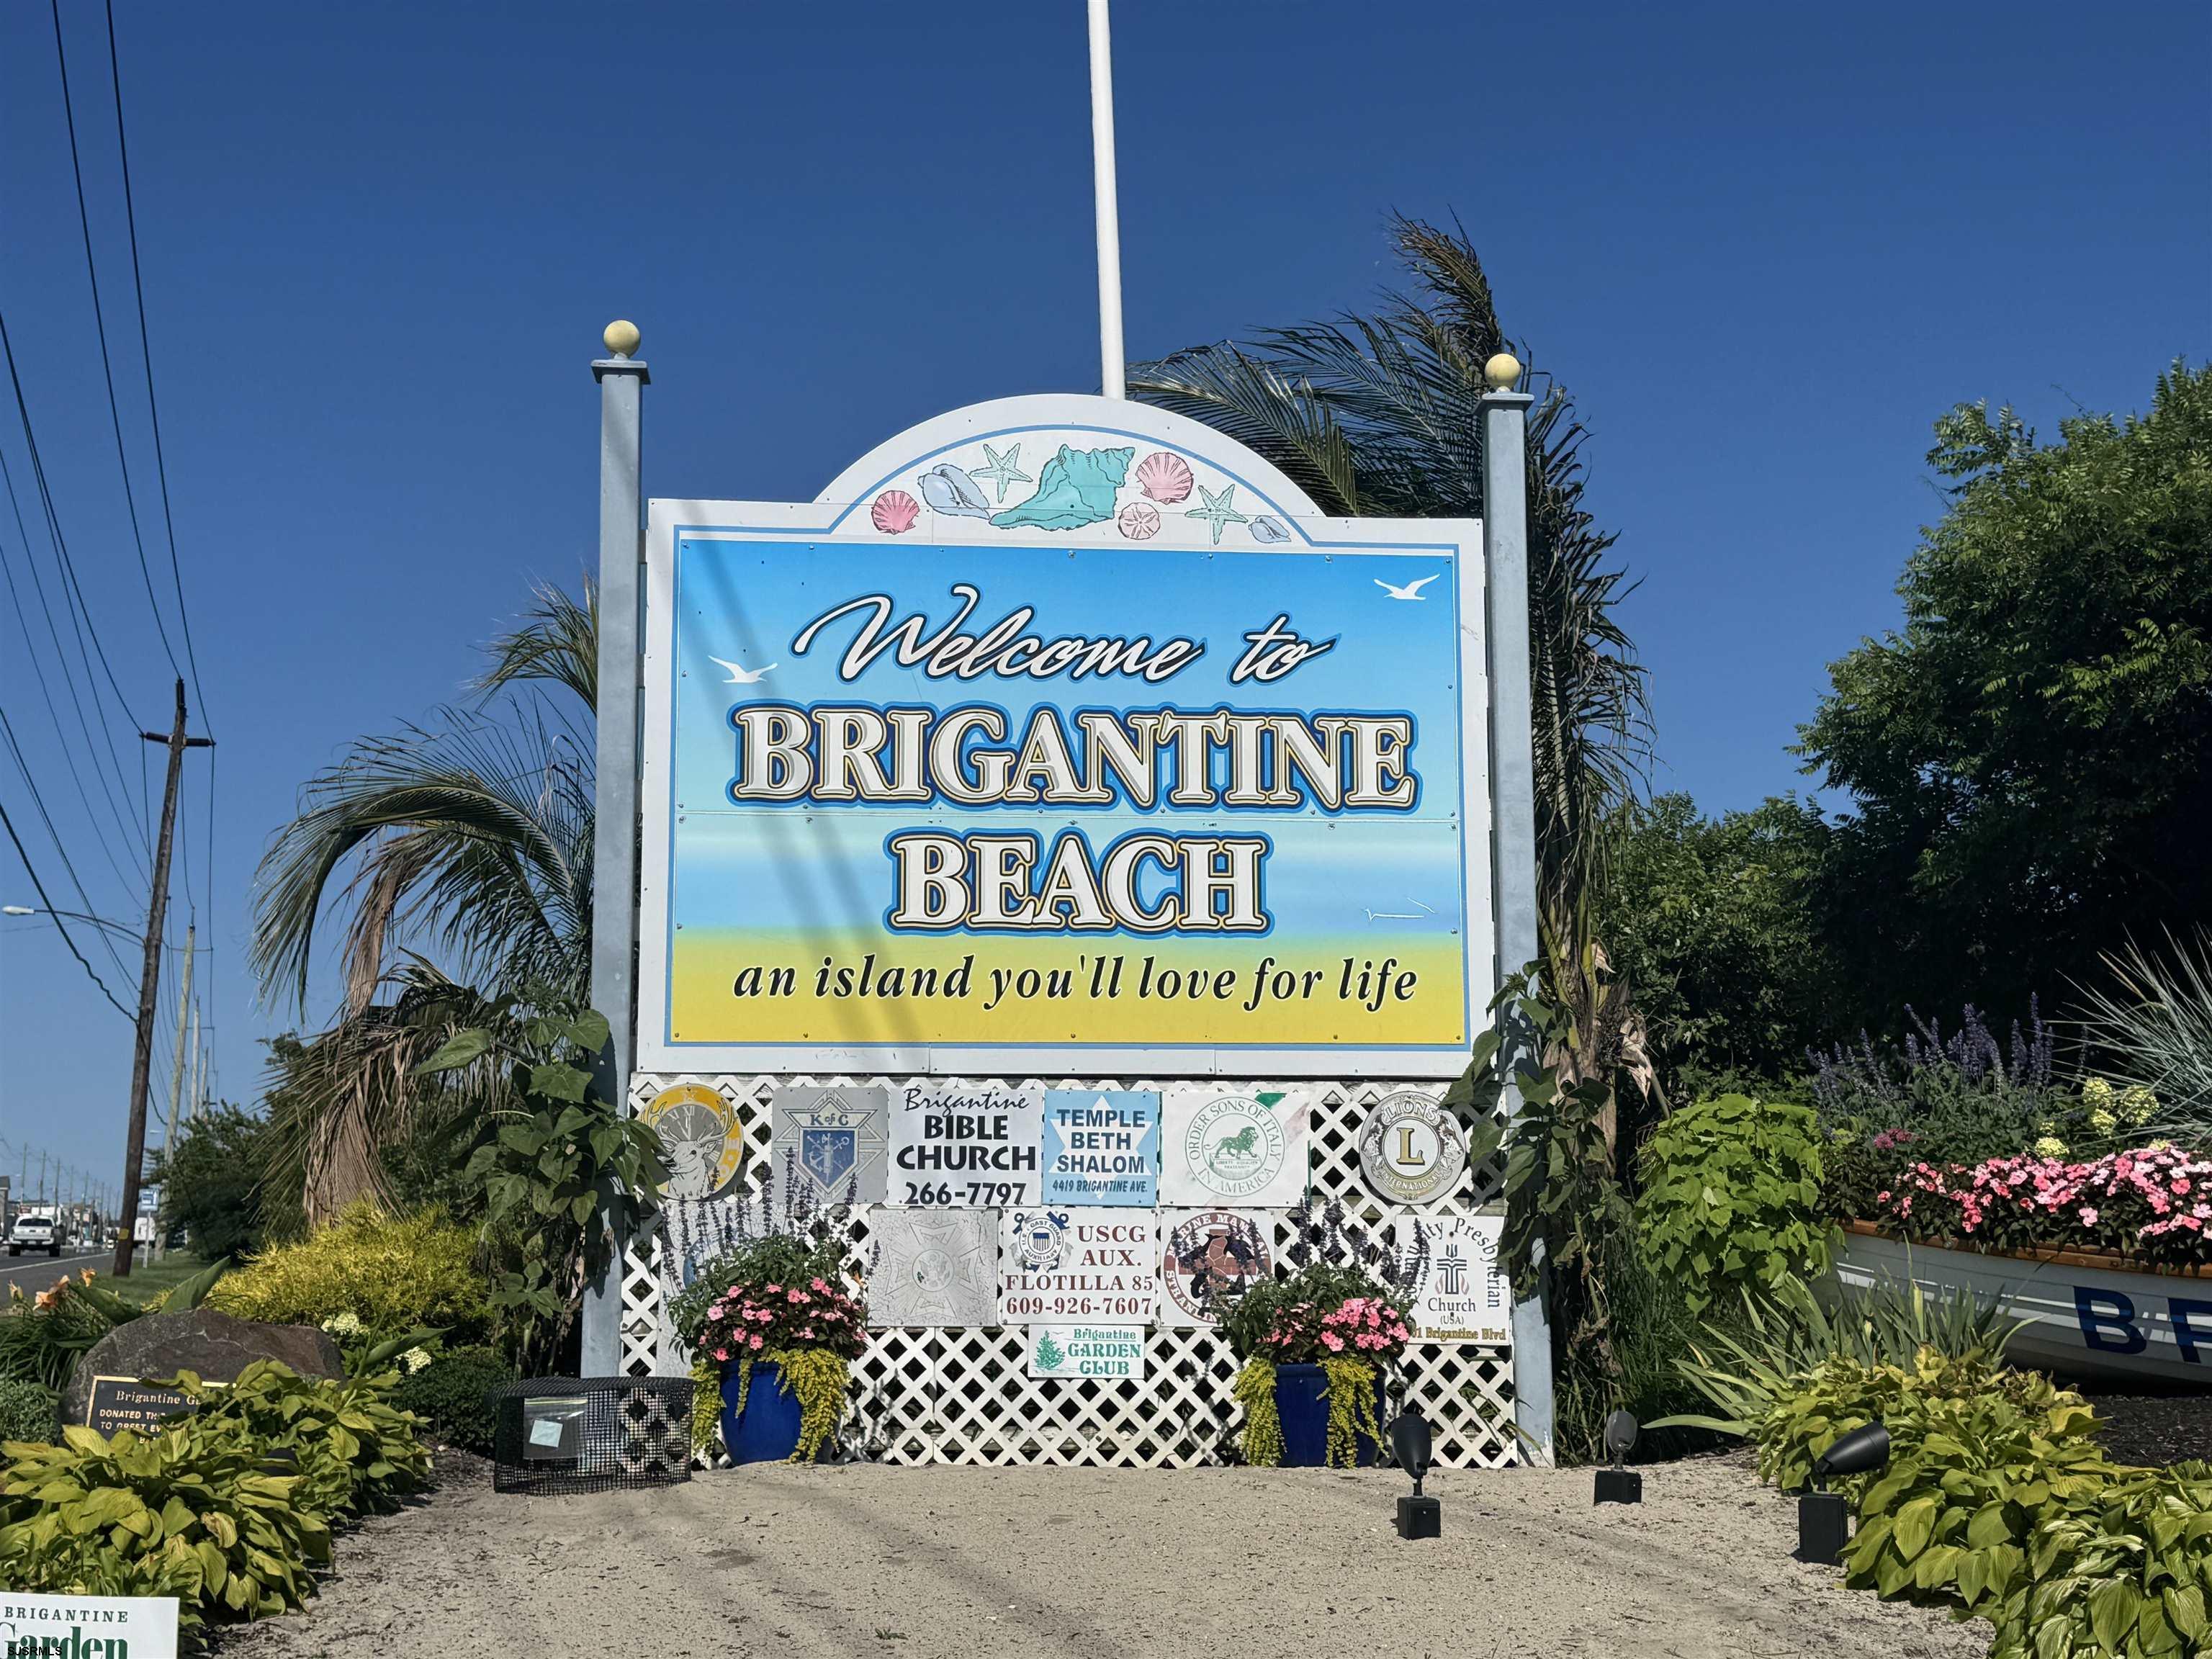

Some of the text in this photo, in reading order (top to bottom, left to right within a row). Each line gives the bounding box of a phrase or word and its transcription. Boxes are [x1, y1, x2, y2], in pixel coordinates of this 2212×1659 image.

[793, 584, 1337, 683] Welcome to
[732, 706, 1416, 810] BRIGANTINE
[889, 833, 1268, 932] BEACH
[734, 954, 1417, 1012] an island you'll love for life
[904, 1087, 1030, 1117] Brigantine
[1384, 1100, 1439, 1122] LIONS
[924, 1115, 1009, 1140] BIBLE
[1056, 1109, 1146, 1128] TEMPLE
[1189, 1100, 1282, 1161] ORDER SONS OF ITALY
[1071, 1132, 1131, 1150] BETH
[1396, 1127, 1426, 1166] L
[896, 1145, 1036, 1171] CHURCH
[1057, 1155, 1145, 1174] SHALOM
[1052, 1179, 1148, 1192] 4419 BRIGANTINE AVE.
[1219, 1167, 1274, 1193] AMERICA
[1381, 1169, 1443, 1191] INTERNATIONAL
[904, 1182, 1027, 1205] 266-7797
[1048, 1224, 1062, 1246] GUARD
[1077, 1226, 1146, 1242] USCG
[1080, 1249, 1141, 1266] AUX.
[1005, 1274, 1152, 1290] FLOTILLA 85
[1007, 1297, 1151, 1314] 609-926-7607
[1428, 1297, 1476, 1312] Church
[1440, 1316, 1465, 1326] (USA)
[1074, 1328, 1136, 1341] Brigantine
[1426, 1326, 1479, 1342] Brigantine
[1481, 1328, 1506, 1341] Blvd
[1068, 1343, 1141, 1357] GARDEN
[1079, 1360, 1130, 1375] CLUB
[116, 1390, 180, 1405] Brigantine
[99, 1409, 141, 1419] DONATED
[100, 1421, 112, 1430] TO
[4, 1606, 128, 1622] BRIGANTINE
[0, 1622, 128, 1659] Garden
